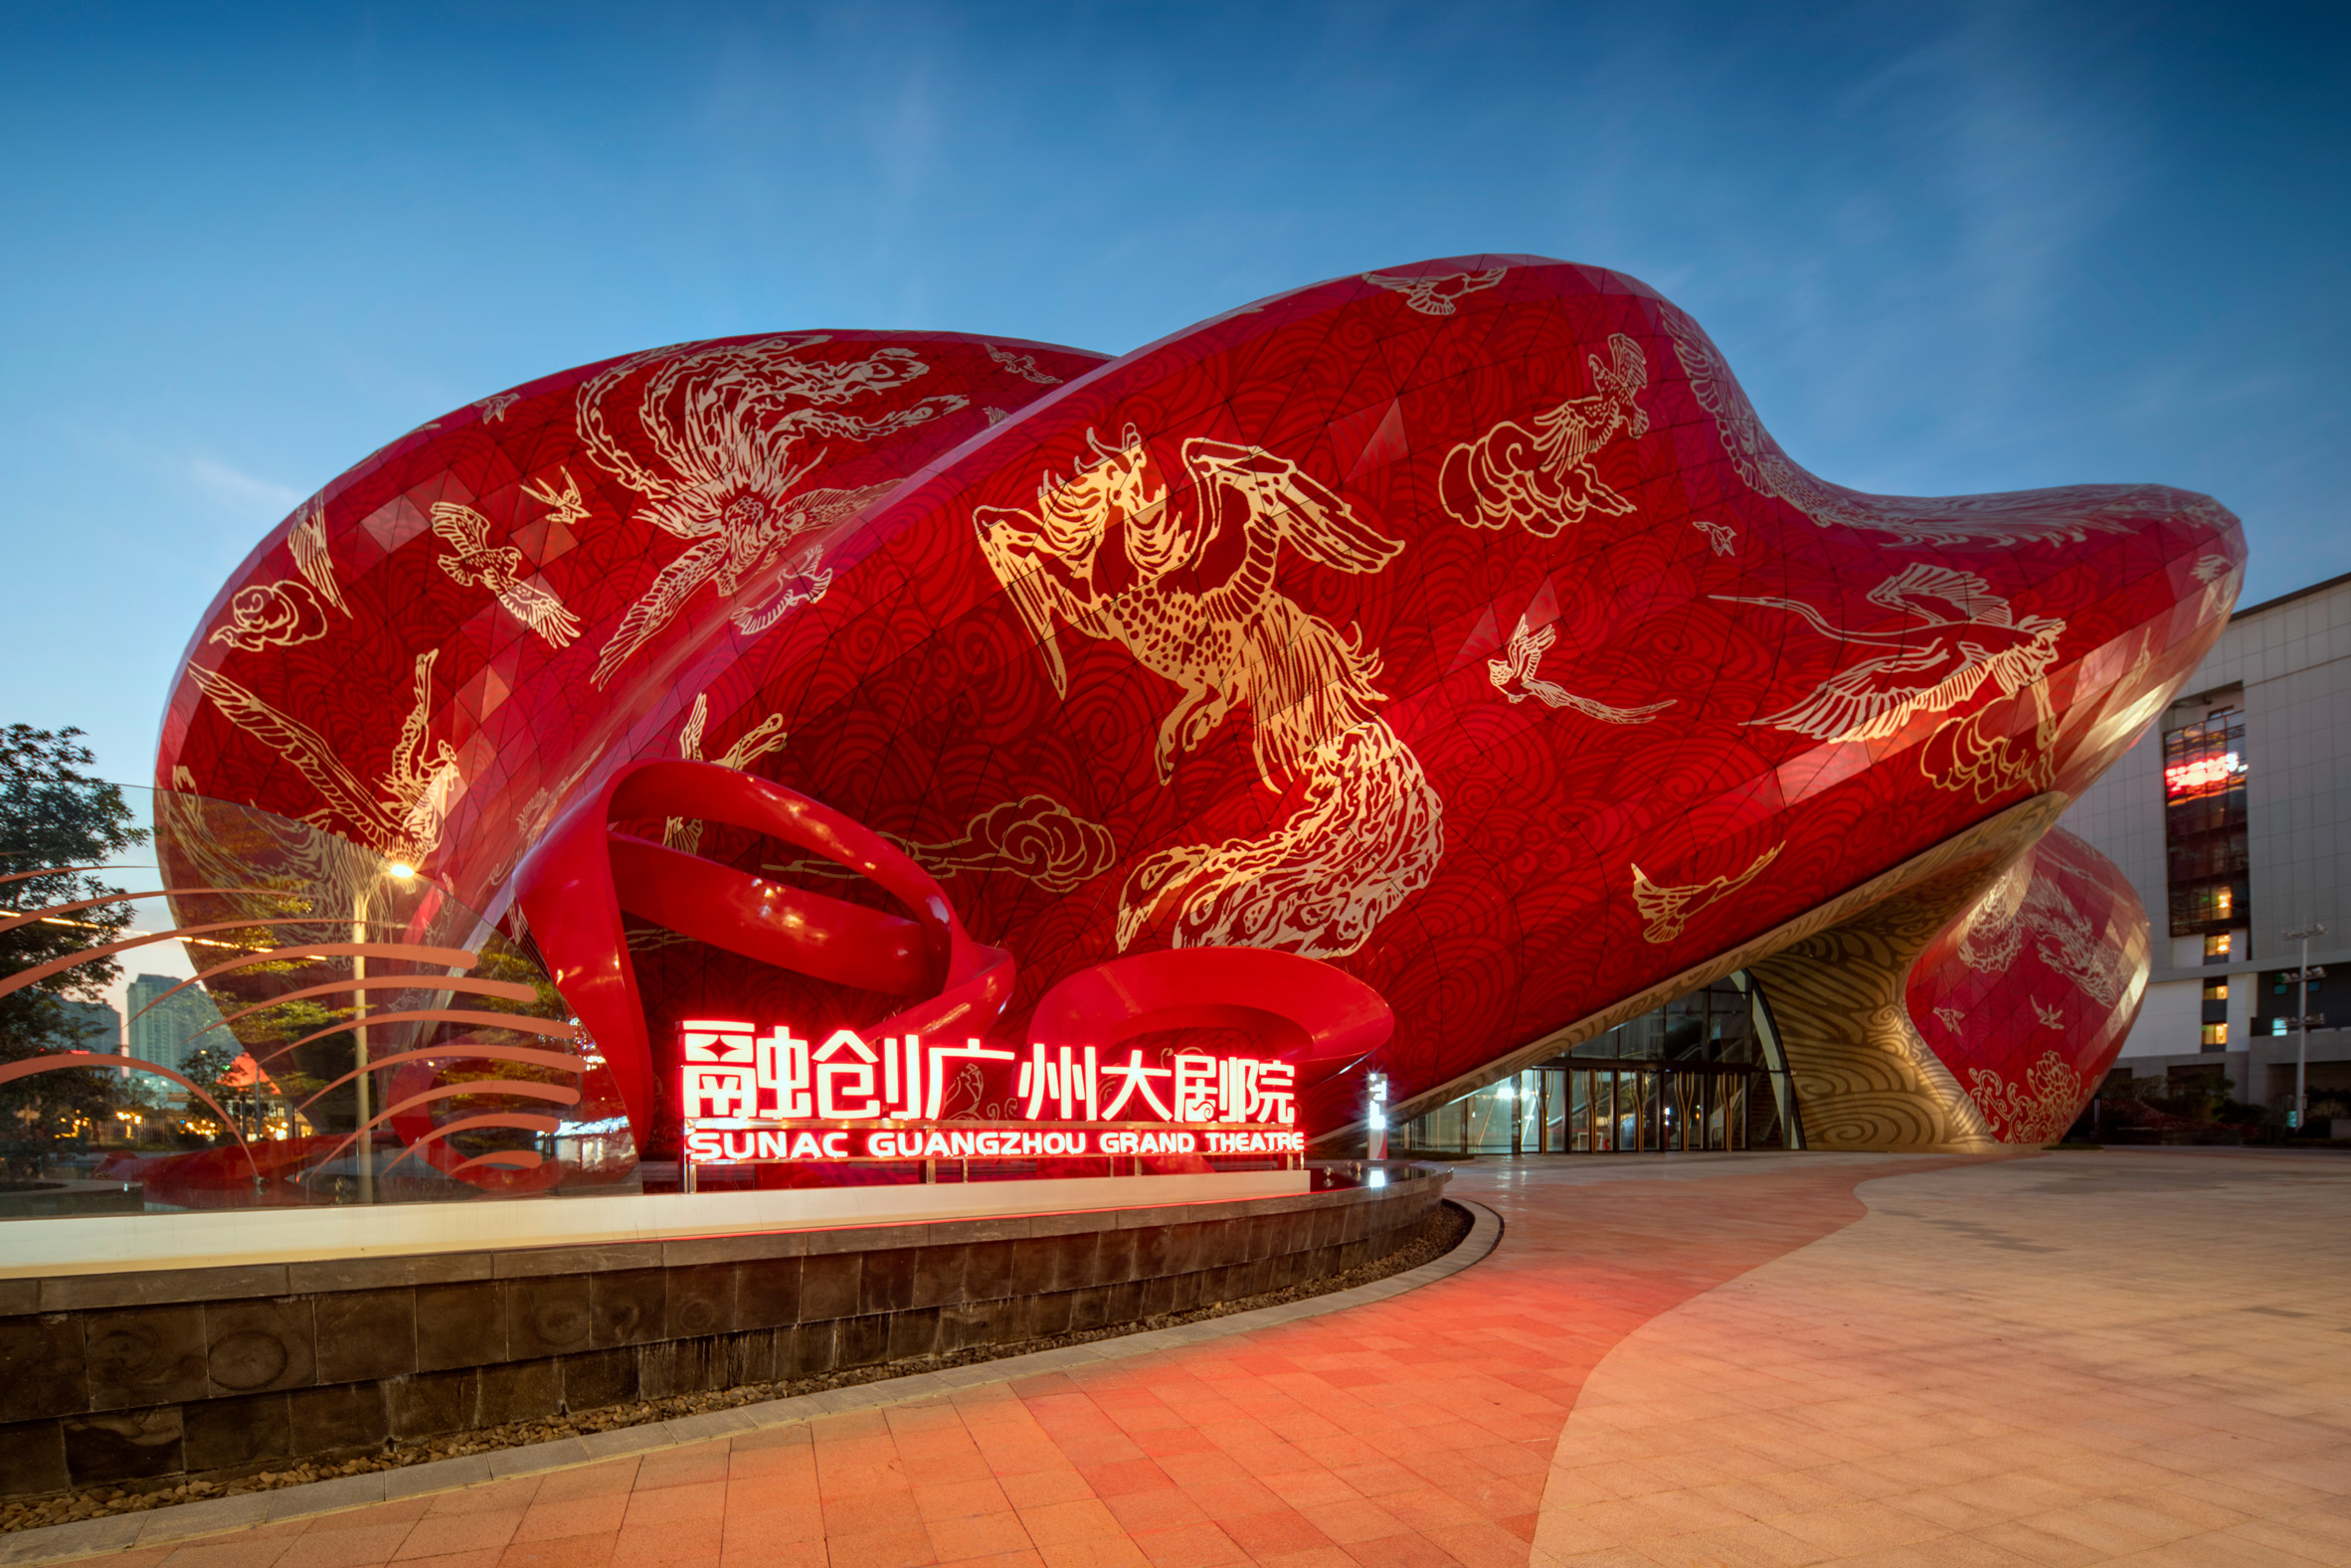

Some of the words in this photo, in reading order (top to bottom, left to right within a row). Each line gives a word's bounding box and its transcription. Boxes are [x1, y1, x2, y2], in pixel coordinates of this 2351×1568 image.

[682, 1020, 1295, 1123] 融创广州大剧院
[688, 1132, 848, 1159] SUNAC
[868, 1132, 1086, 1157] GUANGZHOU
[1100, 1132, 1195, 1154] GRAND
[1205, 1132, 1305, 1153] THEATRE
